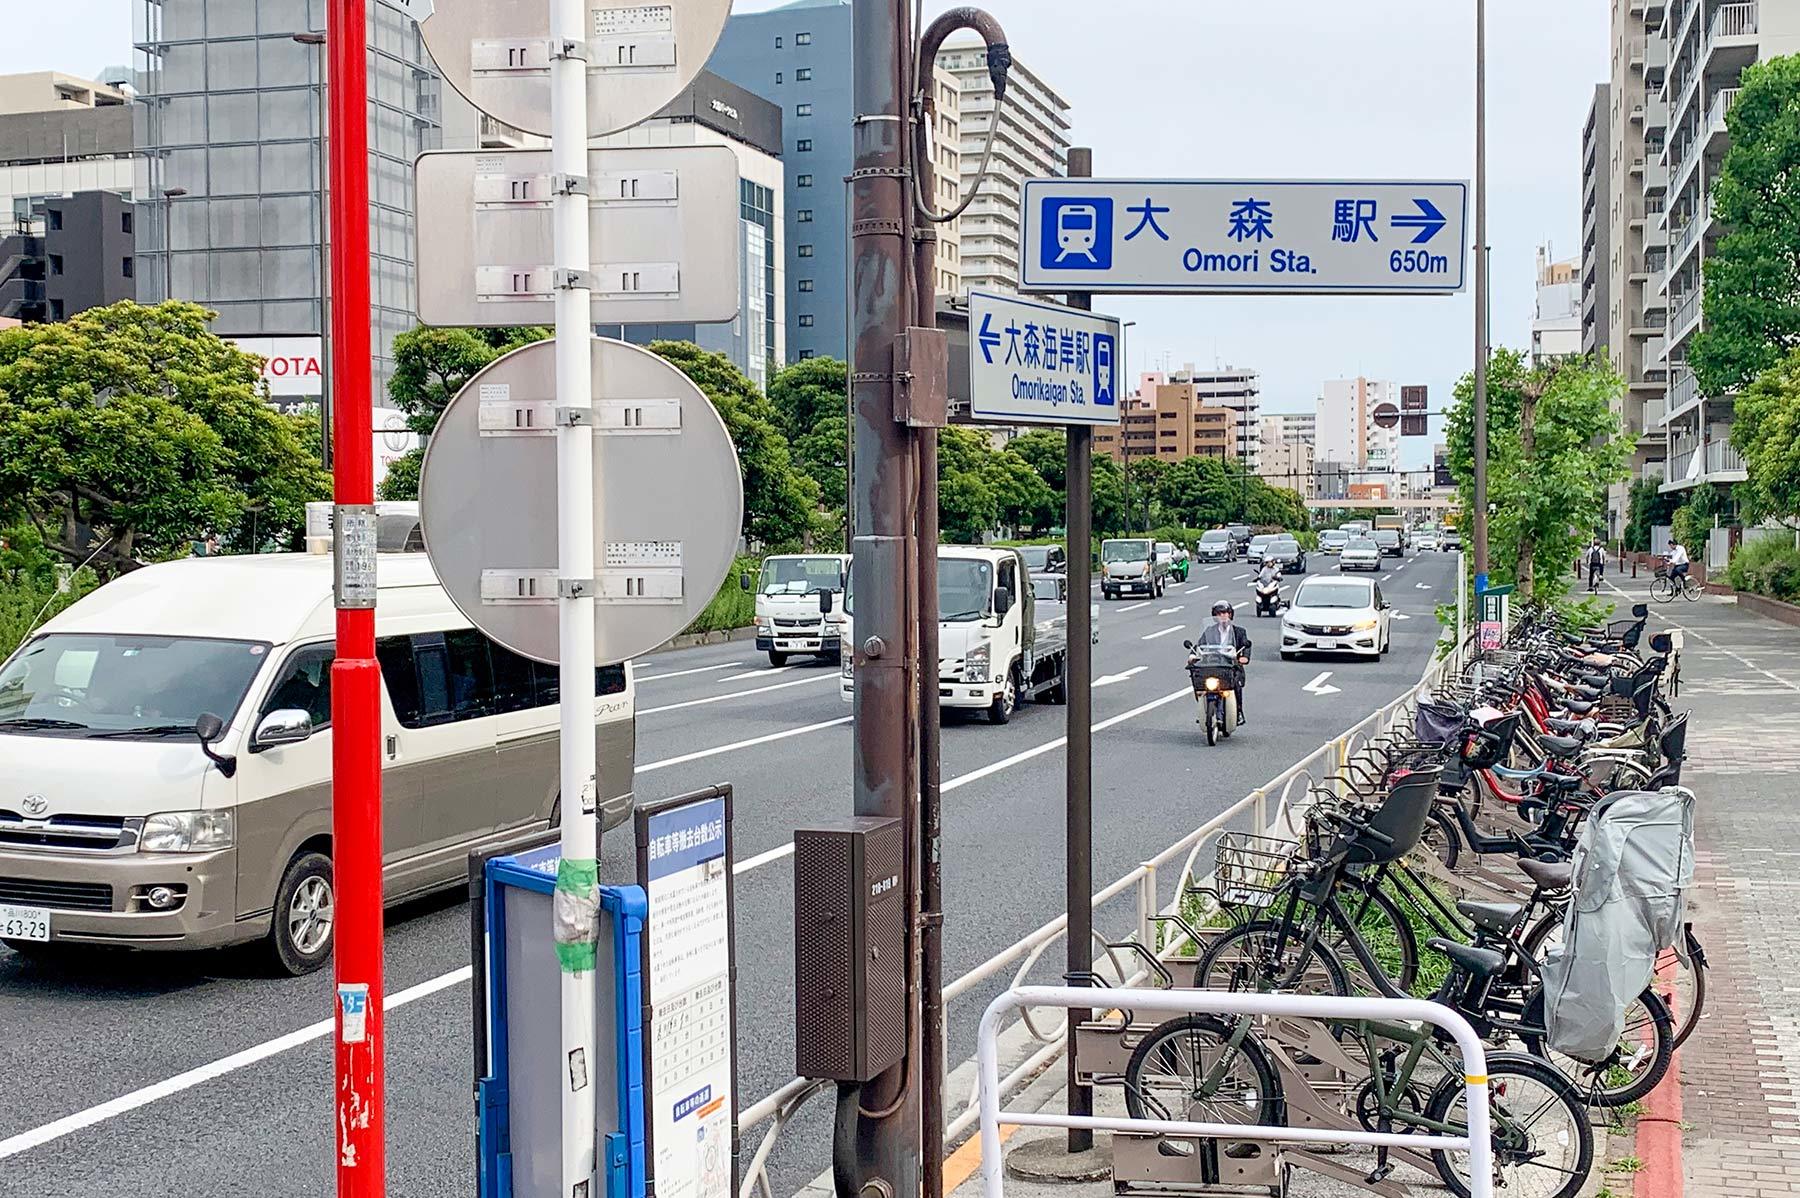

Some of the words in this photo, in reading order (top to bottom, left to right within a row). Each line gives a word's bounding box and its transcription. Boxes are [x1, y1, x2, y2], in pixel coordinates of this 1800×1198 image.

[1183, 248, 1258, 272] Omori
[1270, 249, 1317, 274] Sta.
[1390, 249, 1447, 273] 650m
[1004, 318, 1091, 375] 大森海岸駅
[1012, 372, 1067, 407] Omorikaigan
[1070, 379, 1086, 406] Sta.
[7, 920, 46, 938] 63-29
